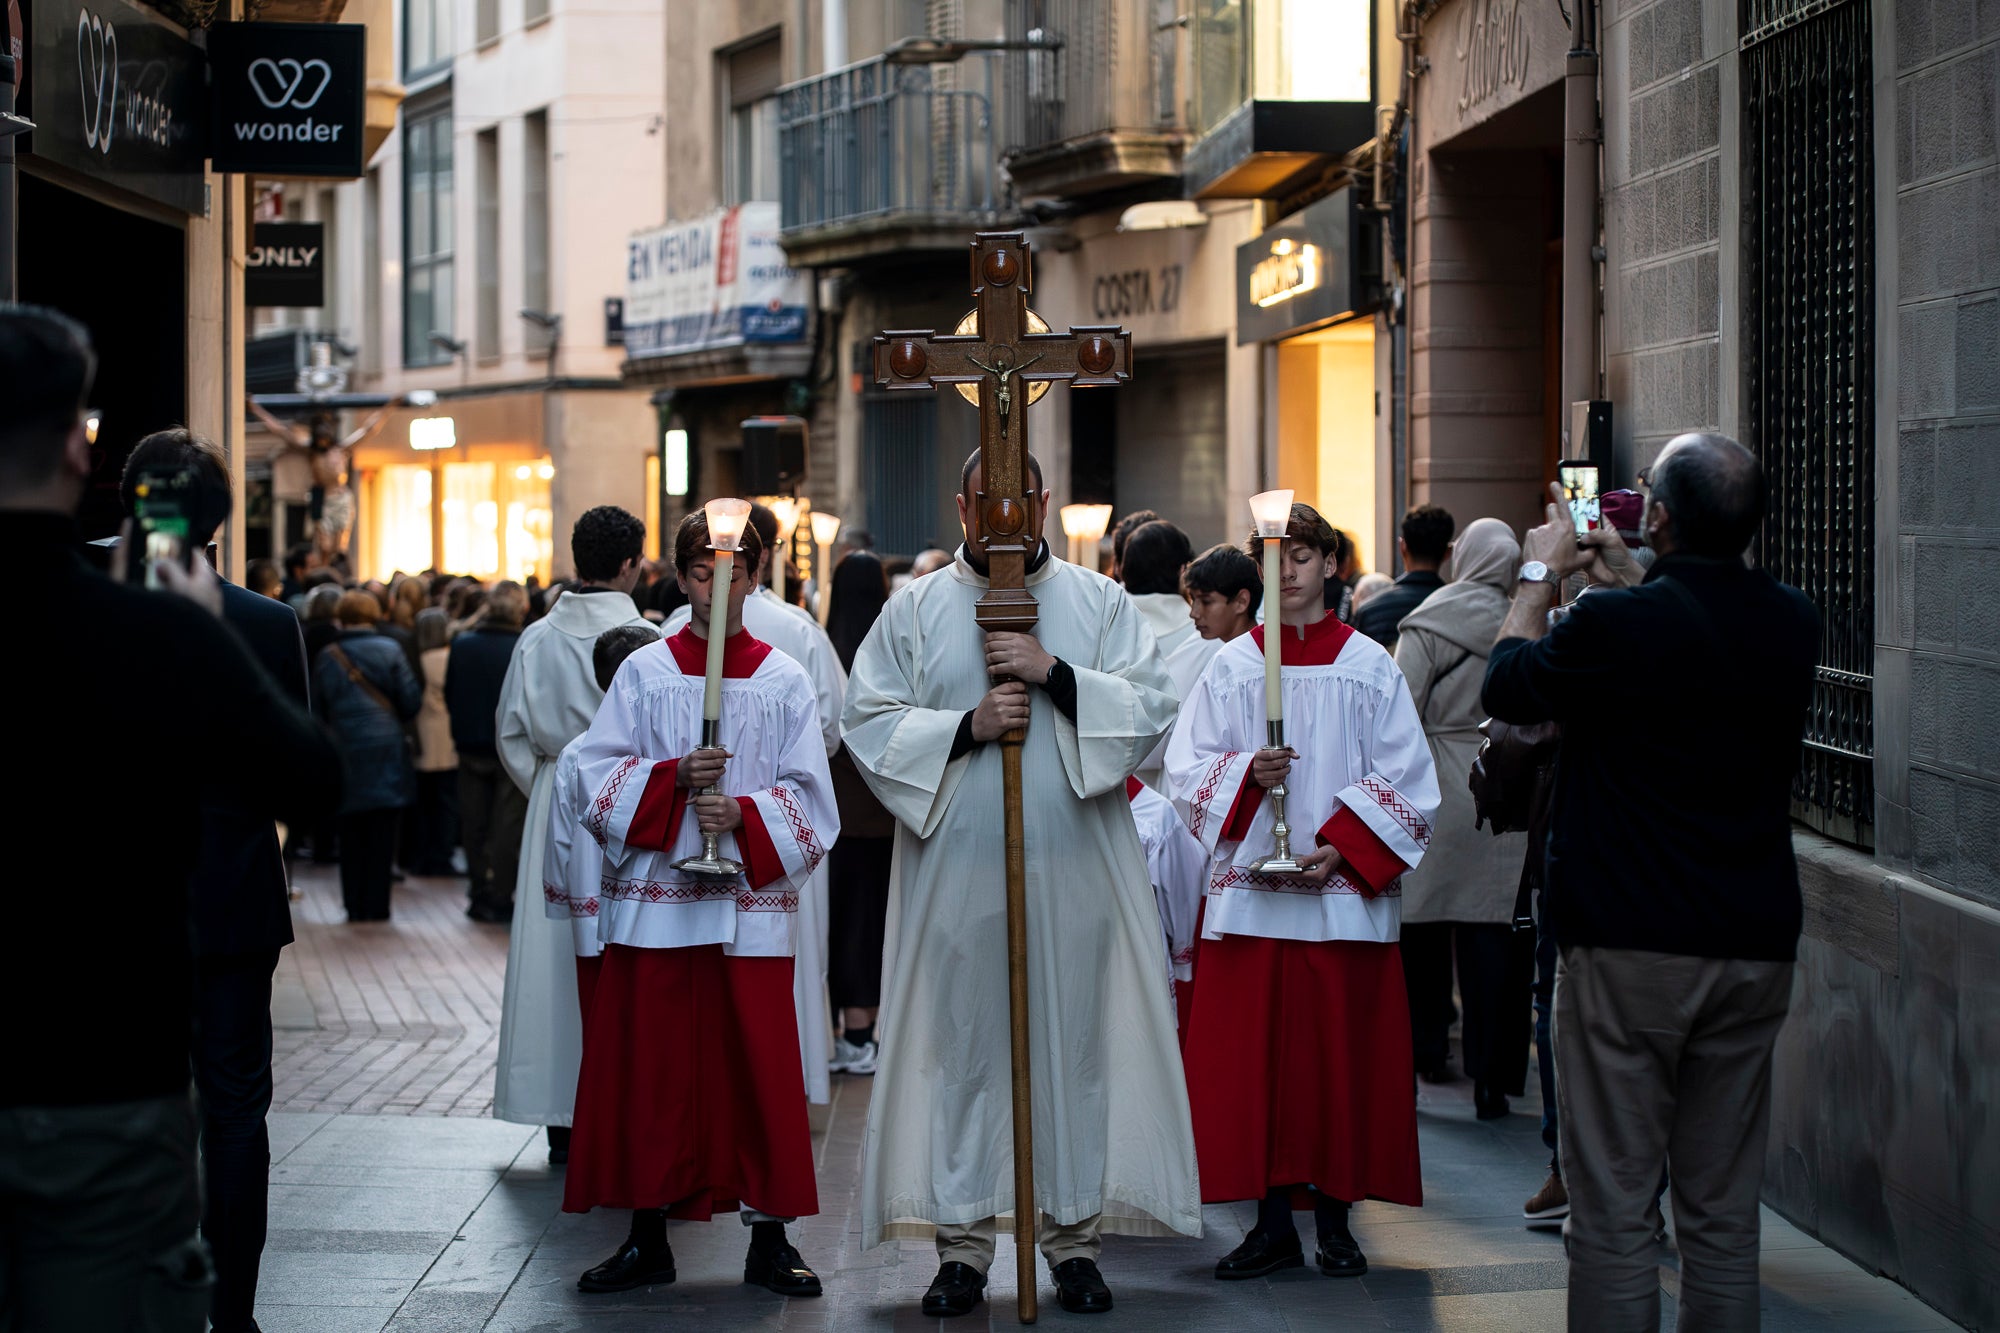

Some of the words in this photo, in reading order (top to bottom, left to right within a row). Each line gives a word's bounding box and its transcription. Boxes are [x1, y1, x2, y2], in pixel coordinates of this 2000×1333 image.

[125, 86, 172, 148] wonder
[234, 117, 343, 142] wonder
[246, 246, 318, 267] ONLY
[629, 238, 651, 282] EN
[658, 226, 712, 274] VENDA
[1093, 267, 1155, 320] COSTA
[1161, 265, 1183, 313] 27
